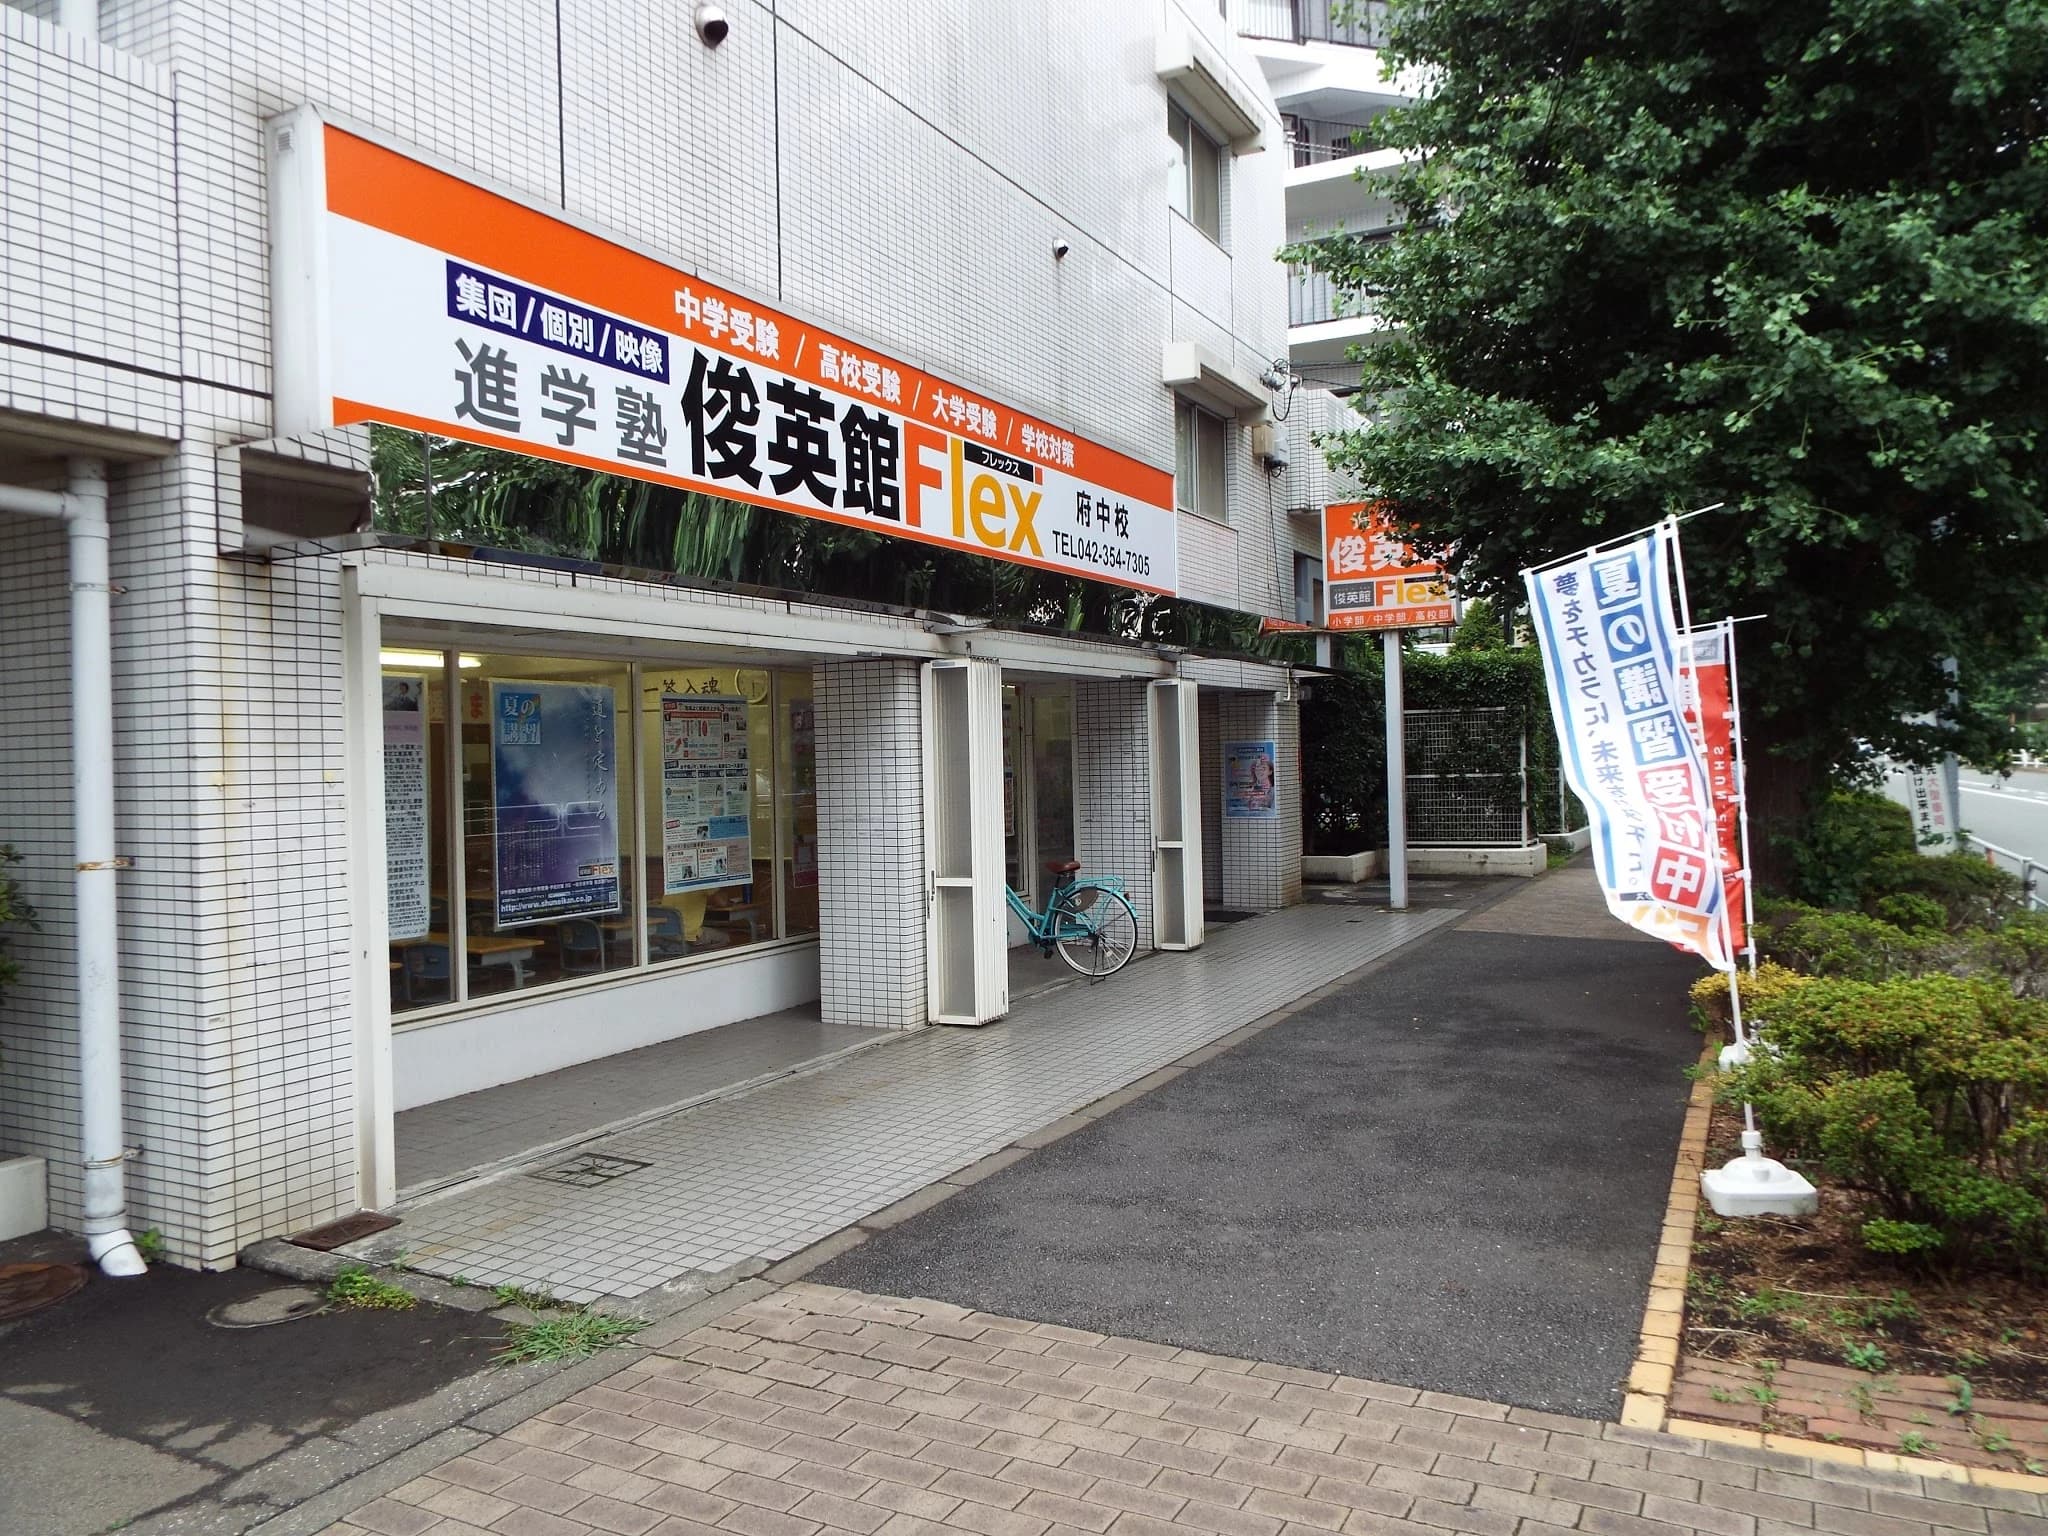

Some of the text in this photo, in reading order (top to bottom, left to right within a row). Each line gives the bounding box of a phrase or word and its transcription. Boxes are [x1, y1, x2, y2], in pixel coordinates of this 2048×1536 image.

[674, 287, 780, 360] 中学受験
[818, 343, 901, 405] 高校受験
[932, 388, 997, 440] 大学受験
[1021, 423, 1075, 468] 学校対策
[454, 337, 1045, 558] 進学塾 俊英館 Flex
[981, 450, 1021, 476] フレックス
[1076, 489, 1129, 540] 府中校
[1052, 529, 1151, 577] TEL042-354-7305
[1334, 590, 1371, 606] 俊英館
[504, 695, 535, 717] 夏の
